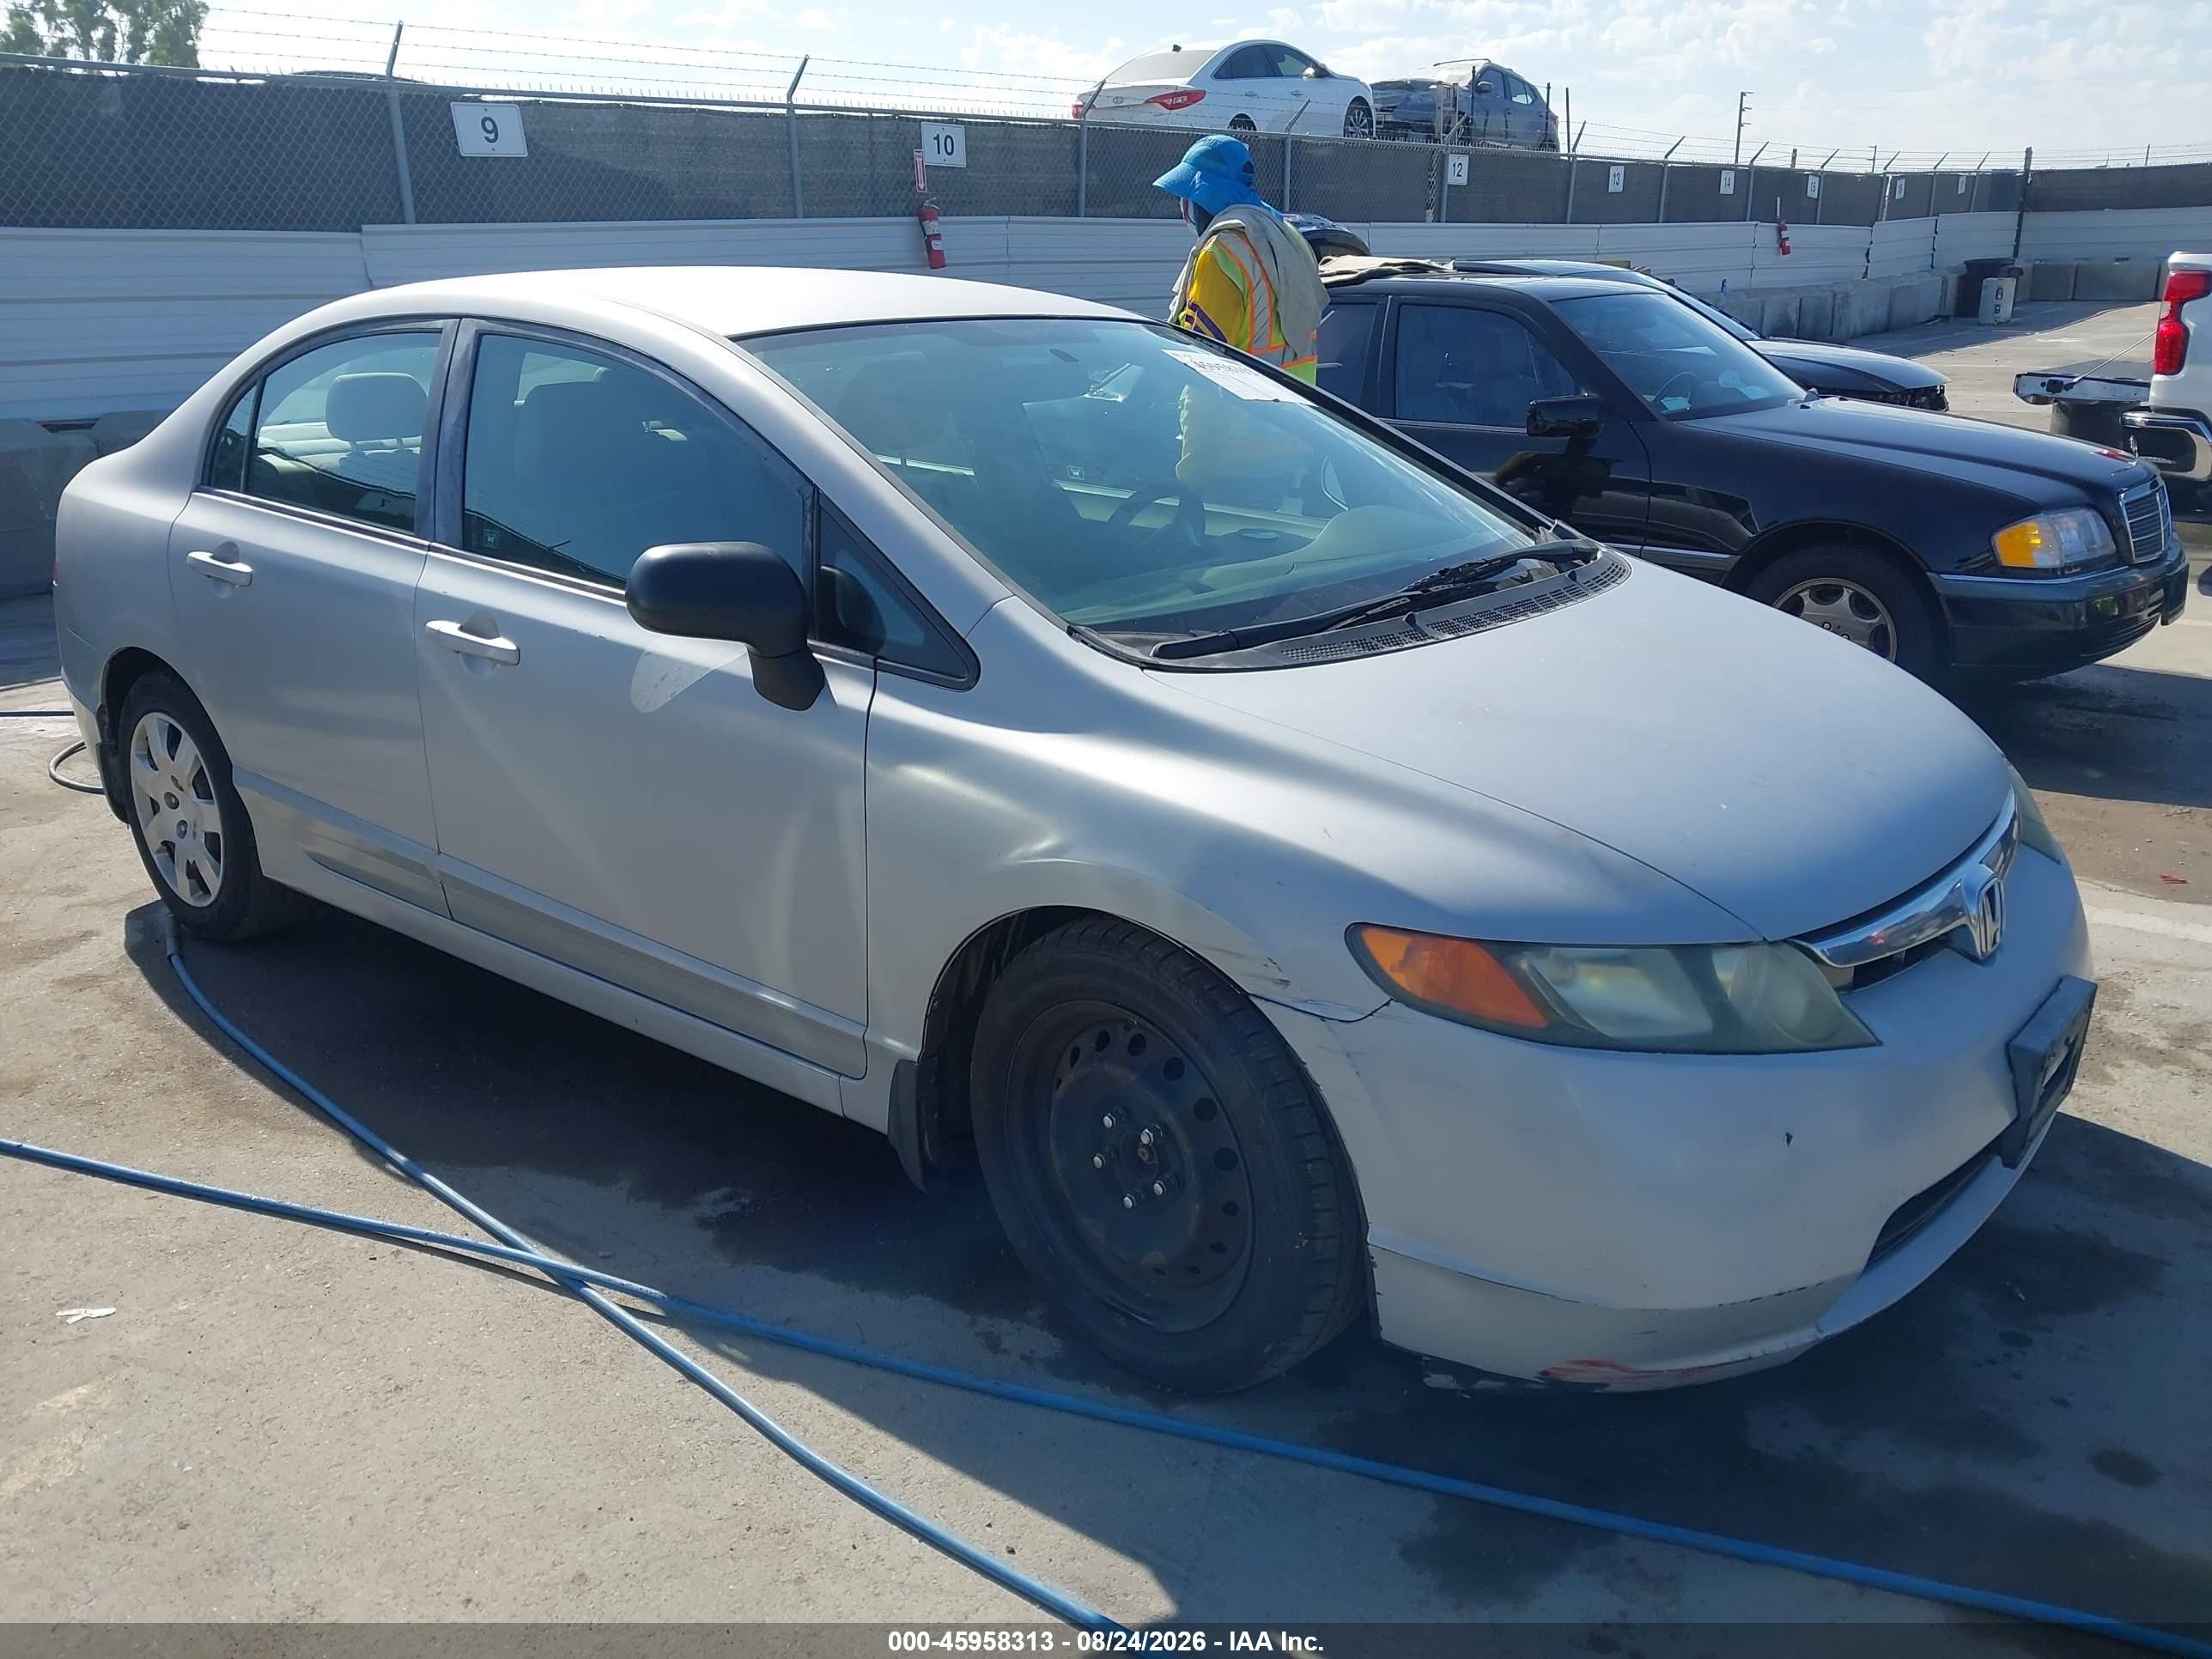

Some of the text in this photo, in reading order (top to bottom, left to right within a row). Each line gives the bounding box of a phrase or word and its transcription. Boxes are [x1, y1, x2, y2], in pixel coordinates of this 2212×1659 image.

[481, 117, 498, 143] 9
[933, 134, 954, 156] 10
[1453, 162, 1462, 177] 12
[1613, 173, 1620, 185] 13
[1724, 176, 1731, 188] 14
